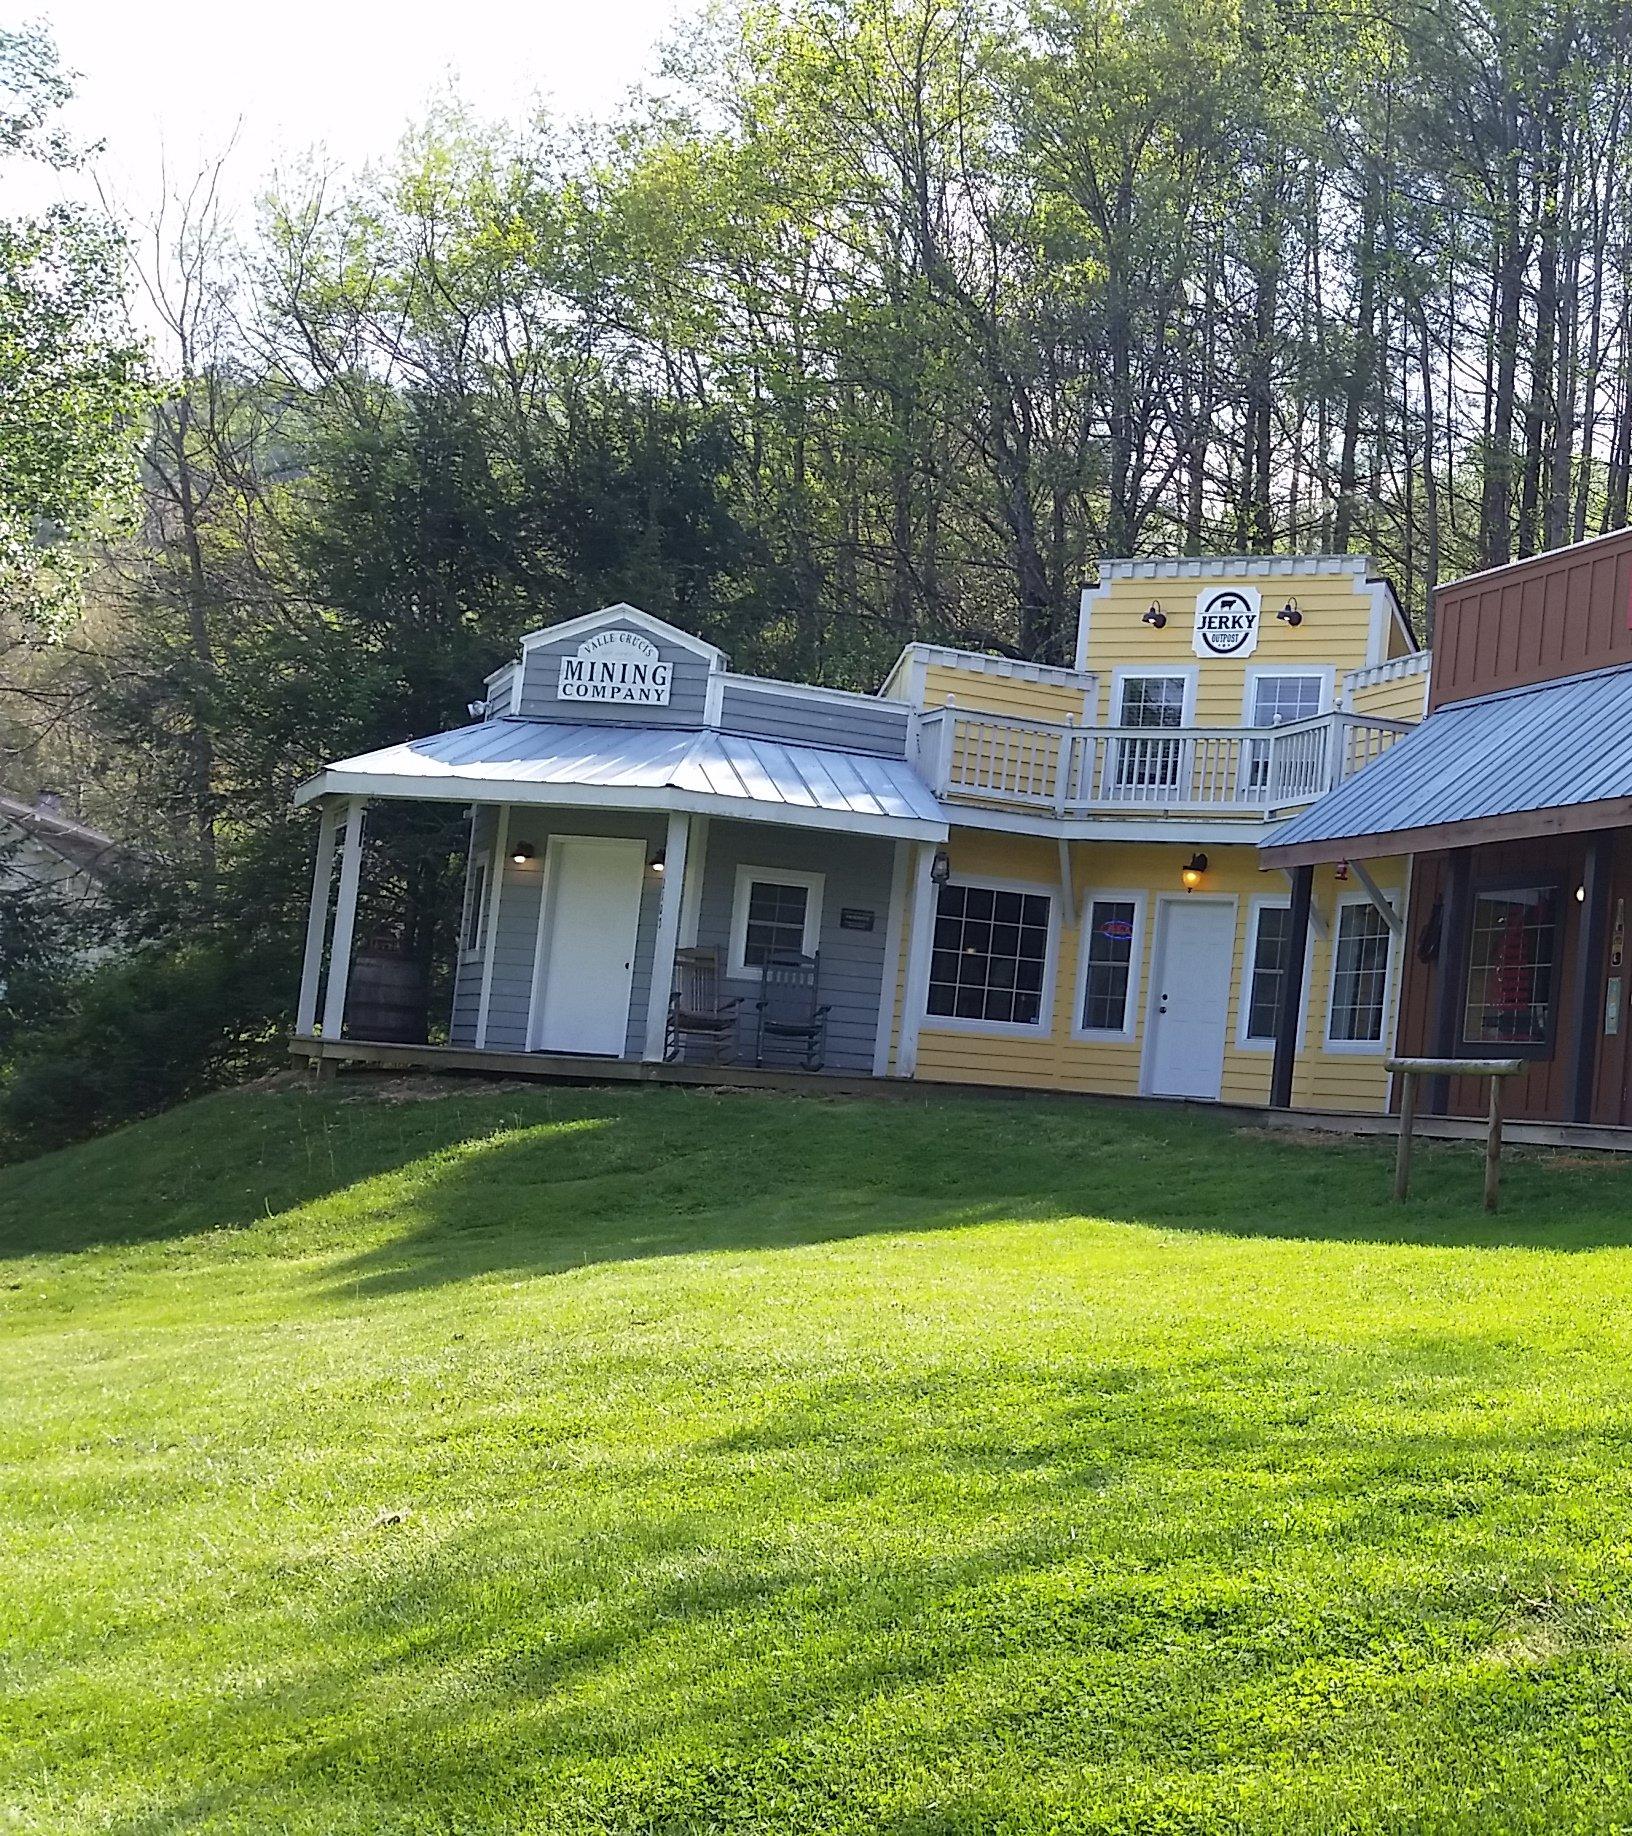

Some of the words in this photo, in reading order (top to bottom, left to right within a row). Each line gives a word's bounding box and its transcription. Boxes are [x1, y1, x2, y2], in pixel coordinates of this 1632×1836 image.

[1197, 615, 1256, 630] JERKY
[584, 633, 615, 654] VALLE
[619, 633, 654, 657] CRUCIS
[1211, 633, 1239, 643] OUTPOST
[564, 660, 667, 686] MINING
[562, 683, 665, 702] COMPANY
